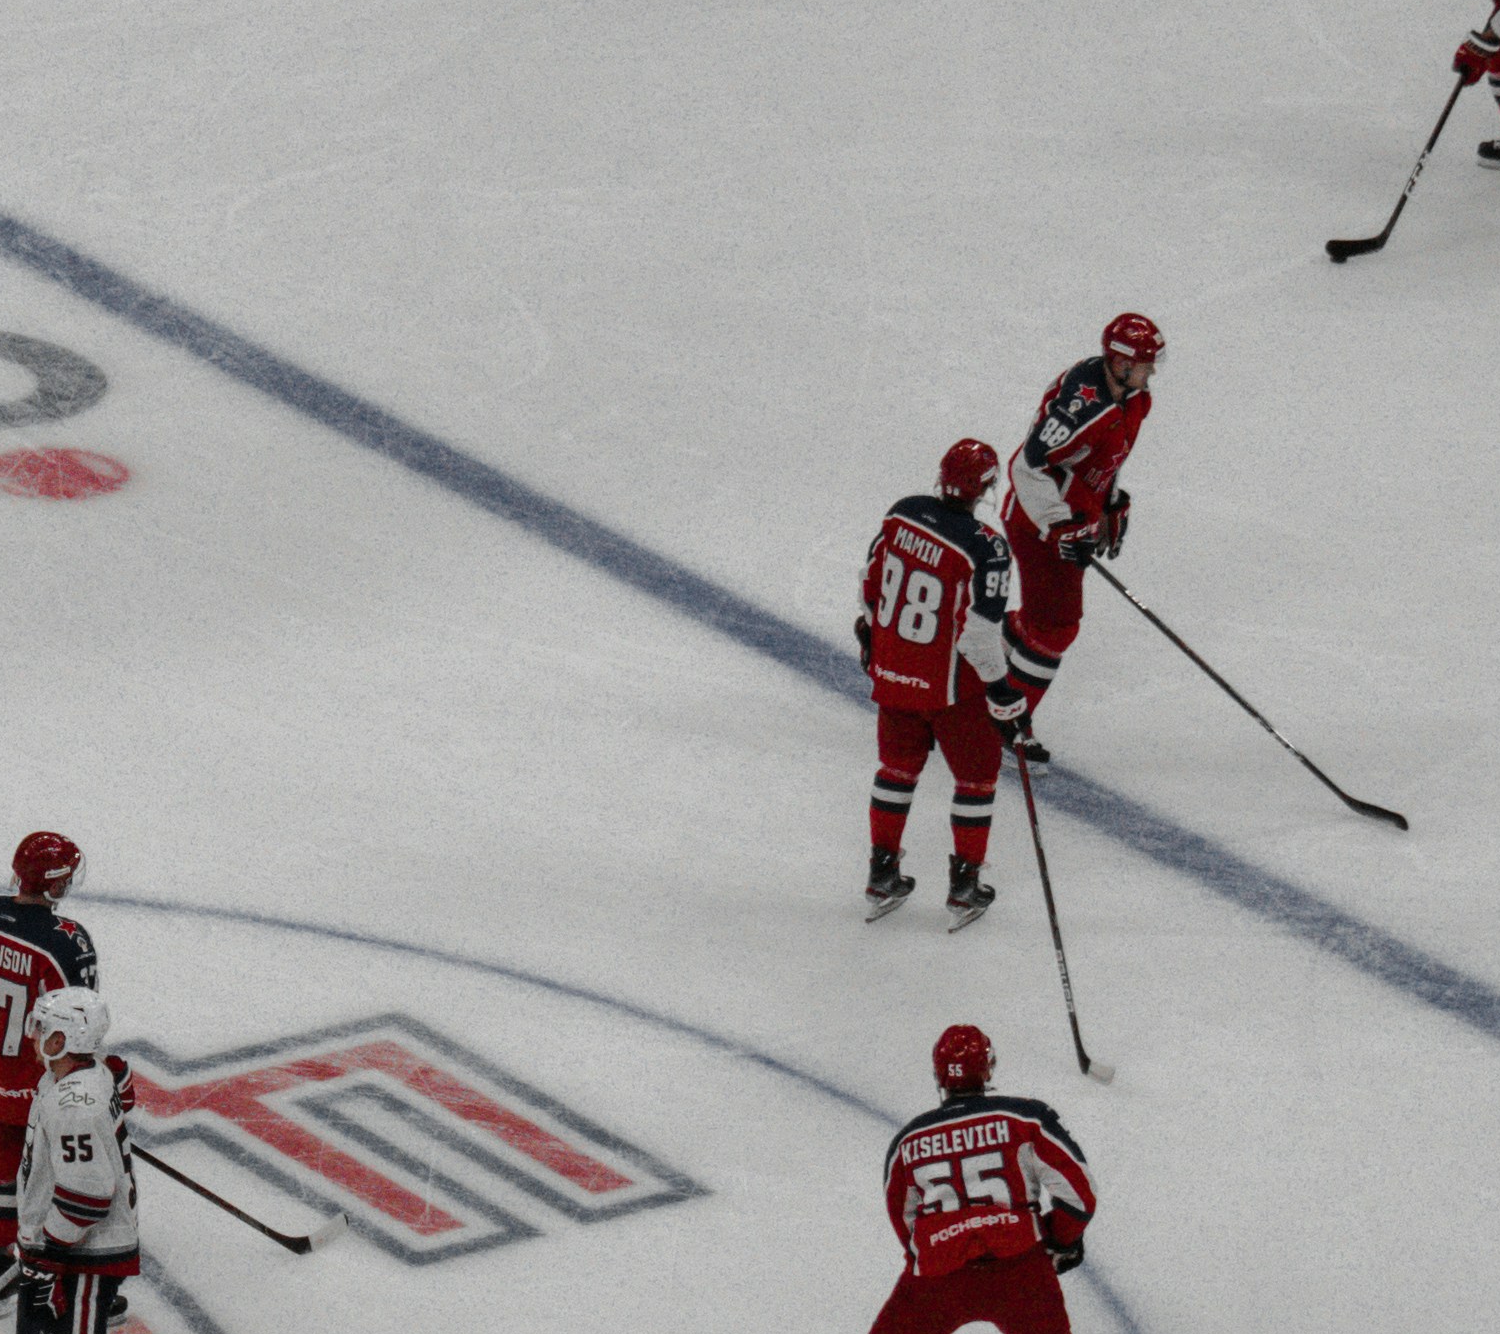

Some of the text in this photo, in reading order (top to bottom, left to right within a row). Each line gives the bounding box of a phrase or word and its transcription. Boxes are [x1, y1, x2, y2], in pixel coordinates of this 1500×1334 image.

[1038, 417, 1071, 447] 88
[894, 526, 944, 568] MAMIN
[876, 554, 944, 645] 98
[984, 570, 1010, 598] 98
[947, 1063, 964, 1078] 55
[60, 1133, 94, 1163] 55
[900, 1119, 1010, 1166] KISELEVICH
[912, 1150, 1012, 1216] 55
[929, 1211, 1020, 1247] РОСНЕФТЬ
